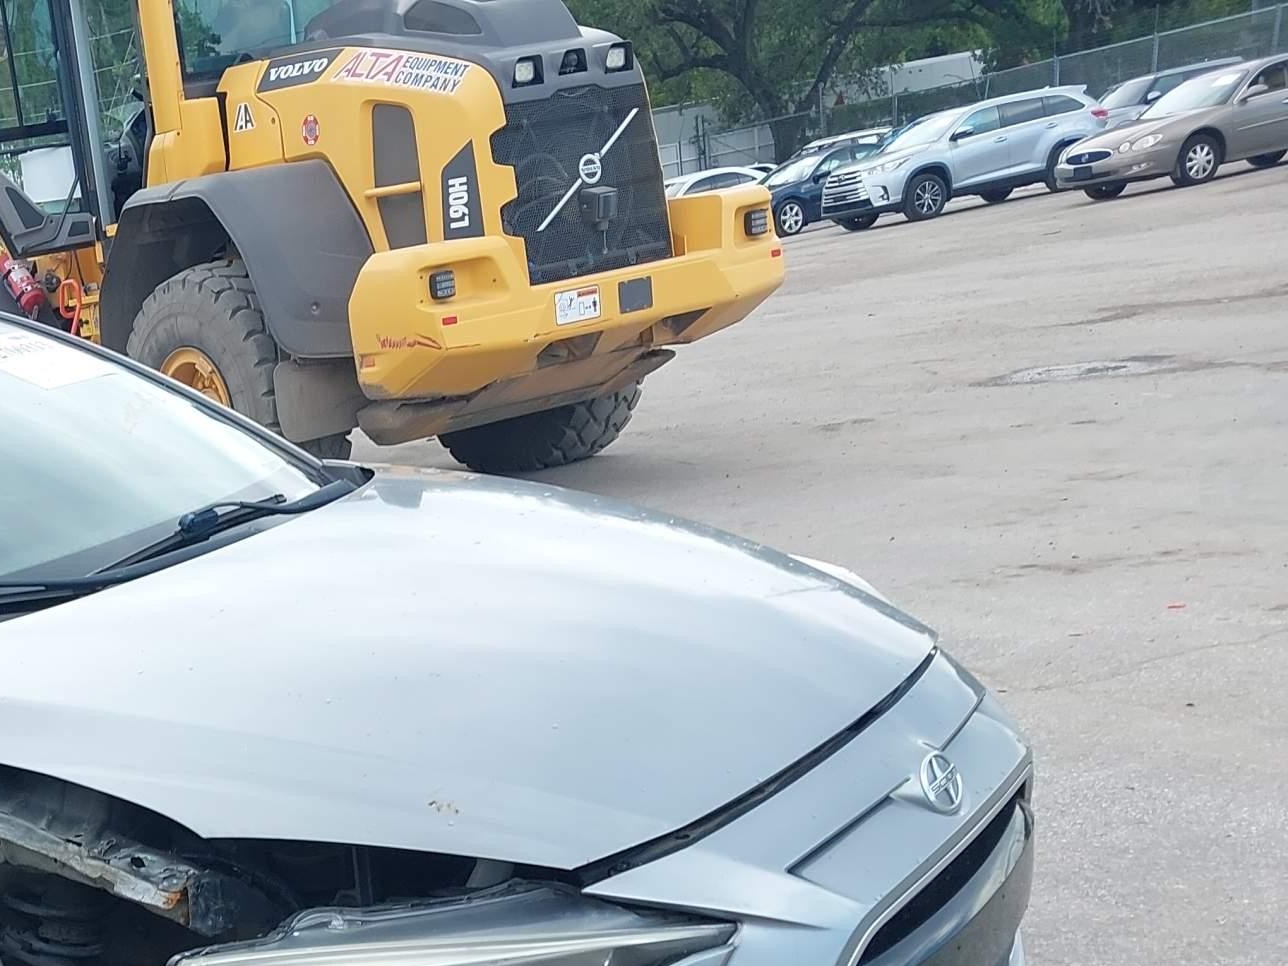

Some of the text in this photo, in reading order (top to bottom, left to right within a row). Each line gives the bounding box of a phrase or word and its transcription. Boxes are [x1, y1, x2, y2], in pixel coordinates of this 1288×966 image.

[269, 57, 329, 81] VOLVO
[333, 51, 405, 81] ALTA
[402, 55, 470, 78] EQUIPMENT
[395, 71, 461, 93] COMPANY
[447, 176, 470, 230] L90H
